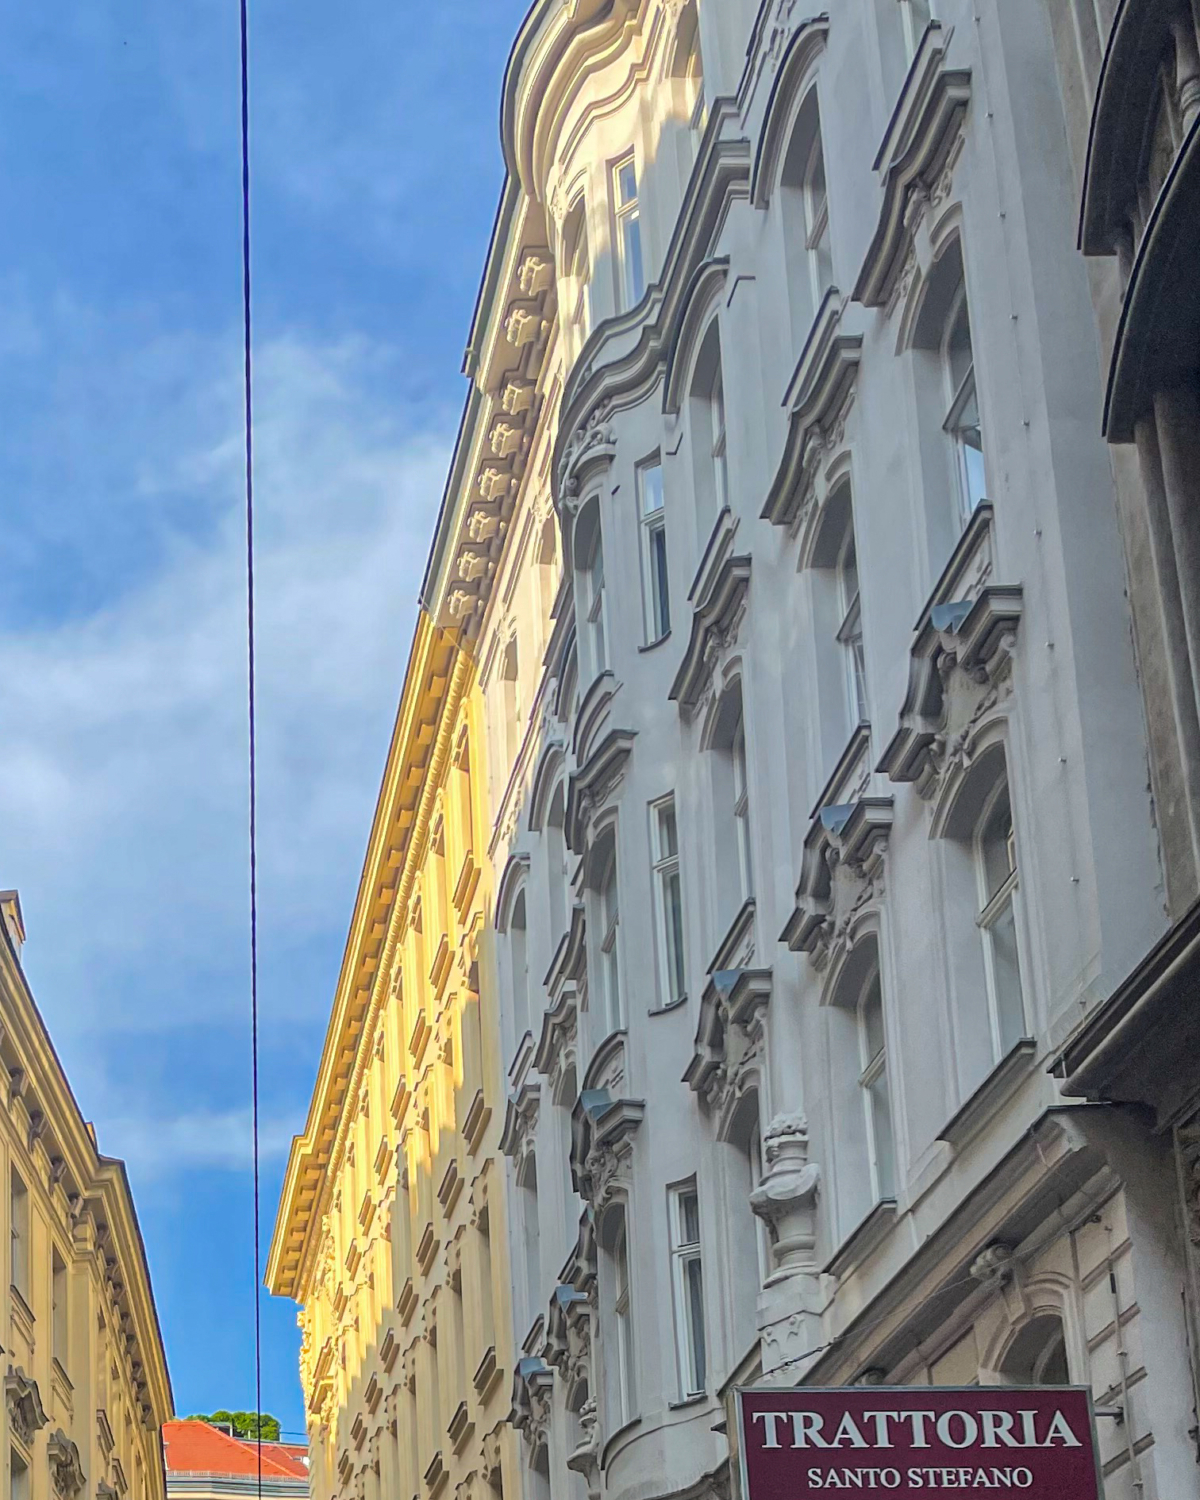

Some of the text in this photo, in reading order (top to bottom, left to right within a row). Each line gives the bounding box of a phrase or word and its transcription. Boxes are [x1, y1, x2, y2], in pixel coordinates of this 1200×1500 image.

[752, 1410, 1083, 1449] TRATTORIA
[808, 1467, 1033, 1489] SANTO STEFANO
